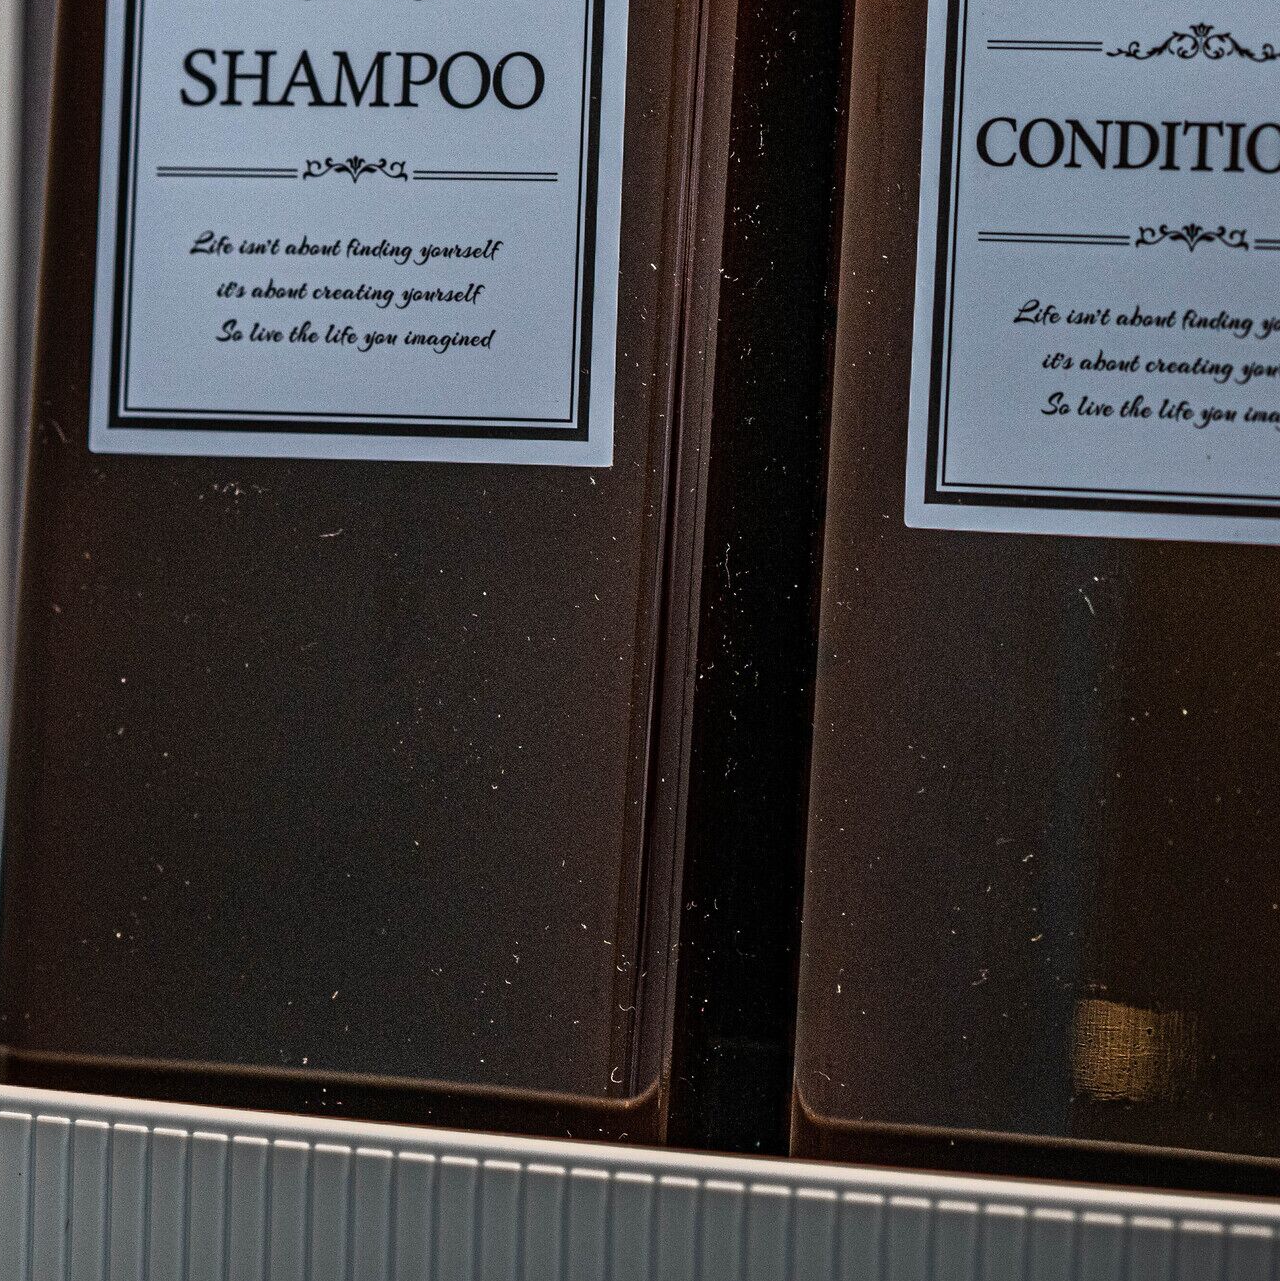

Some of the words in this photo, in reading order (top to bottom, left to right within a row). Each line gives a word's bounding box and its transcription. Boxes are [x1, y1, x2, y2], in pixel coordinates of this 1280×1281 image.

[180, 48, 546, 111] SHAMPOO
[189, 230, 233, 255] Life
[238, 238, 281, 256] isn't
[284, 235, 342, 257] about
[346, 237, 413, 266] finding
[413, 238, 504, 266] yourself
[216, 281, 246, 299] it's
[250, 278, 308, 300] about
[311, 283, 395, 309] creating
[397, 282, 486, 310] yourself
[215, 318, 244, 343] So
[248, 322, 284, 343] live
[288, 320, 319, 344] the
[324, 323, 358, 345] life
[357, 331, 398, 353] you
[403, 329, 497, 355] imagined
[1012, 298, 1061, 325] Life
[1065, 308, 1111, 326] isn't
[1115, 305, 1177, 328] about
[1181, 308, 1254, 339] finding
[1041, 352, 1074, 371] it's
[1079, 349, 1140, 373] about
[1144, 357, 1234, 384] creating
[1040, 390, 1071, 416] So
[1076, 395, 1114, 418] live
[1119, 394, 1152, 419] the
[1157, 398, 1194, 421] life
[1194, 406, 1238, 430] you
